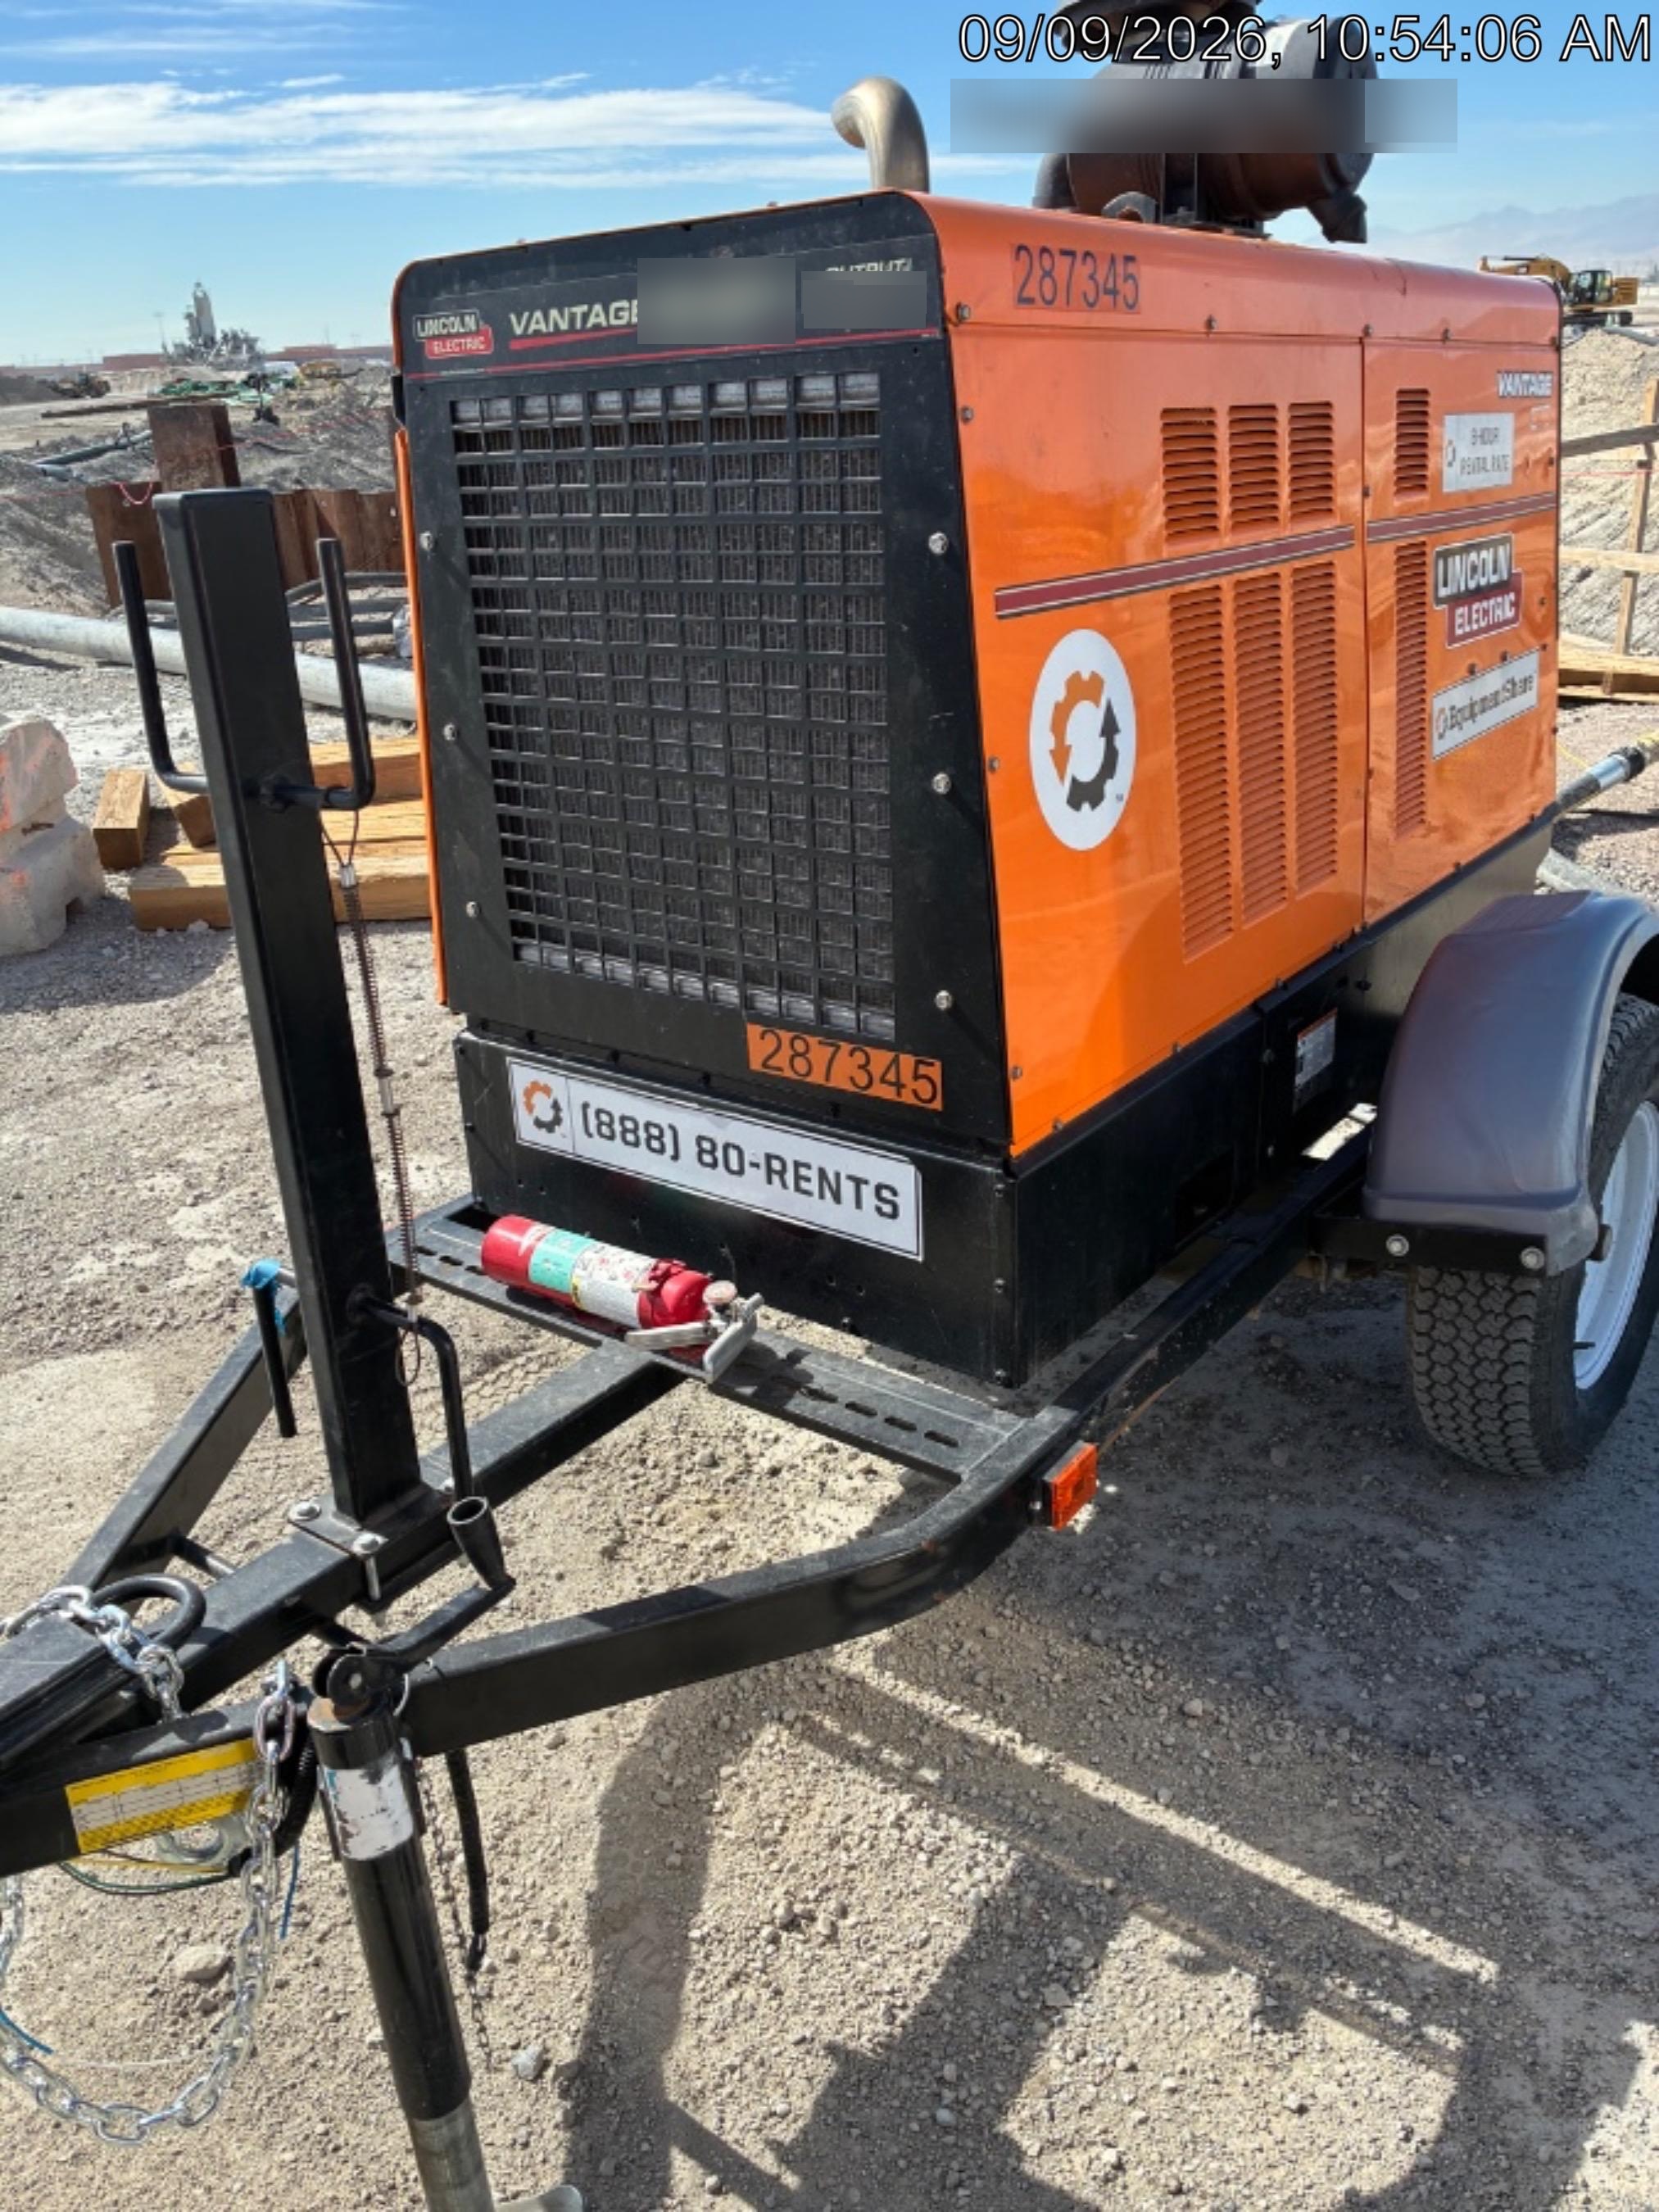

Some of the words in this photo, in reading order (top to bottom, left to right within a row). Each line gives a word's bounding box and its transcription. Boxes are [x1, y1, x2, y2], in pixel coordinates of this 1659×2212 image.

[1014, 244, 1139, 311] 287345
[416, 314, 478, 338] LINCOLN
[433, 336, 485, 355] ELECTRIC
[1497, 371, 1553, 397] VANTAGE
[1437, 544, 1510, 598] LINCOLN
[1454, 592, 1516, 636] ELECTRIC
[1448, 674, 1534, 732] EquipmentShare
[758, 1028, 939, 1105] 287345
[581, 1100, 681, 1162] (888)
[694, 1134, 901, 1221] 80-RENTS
